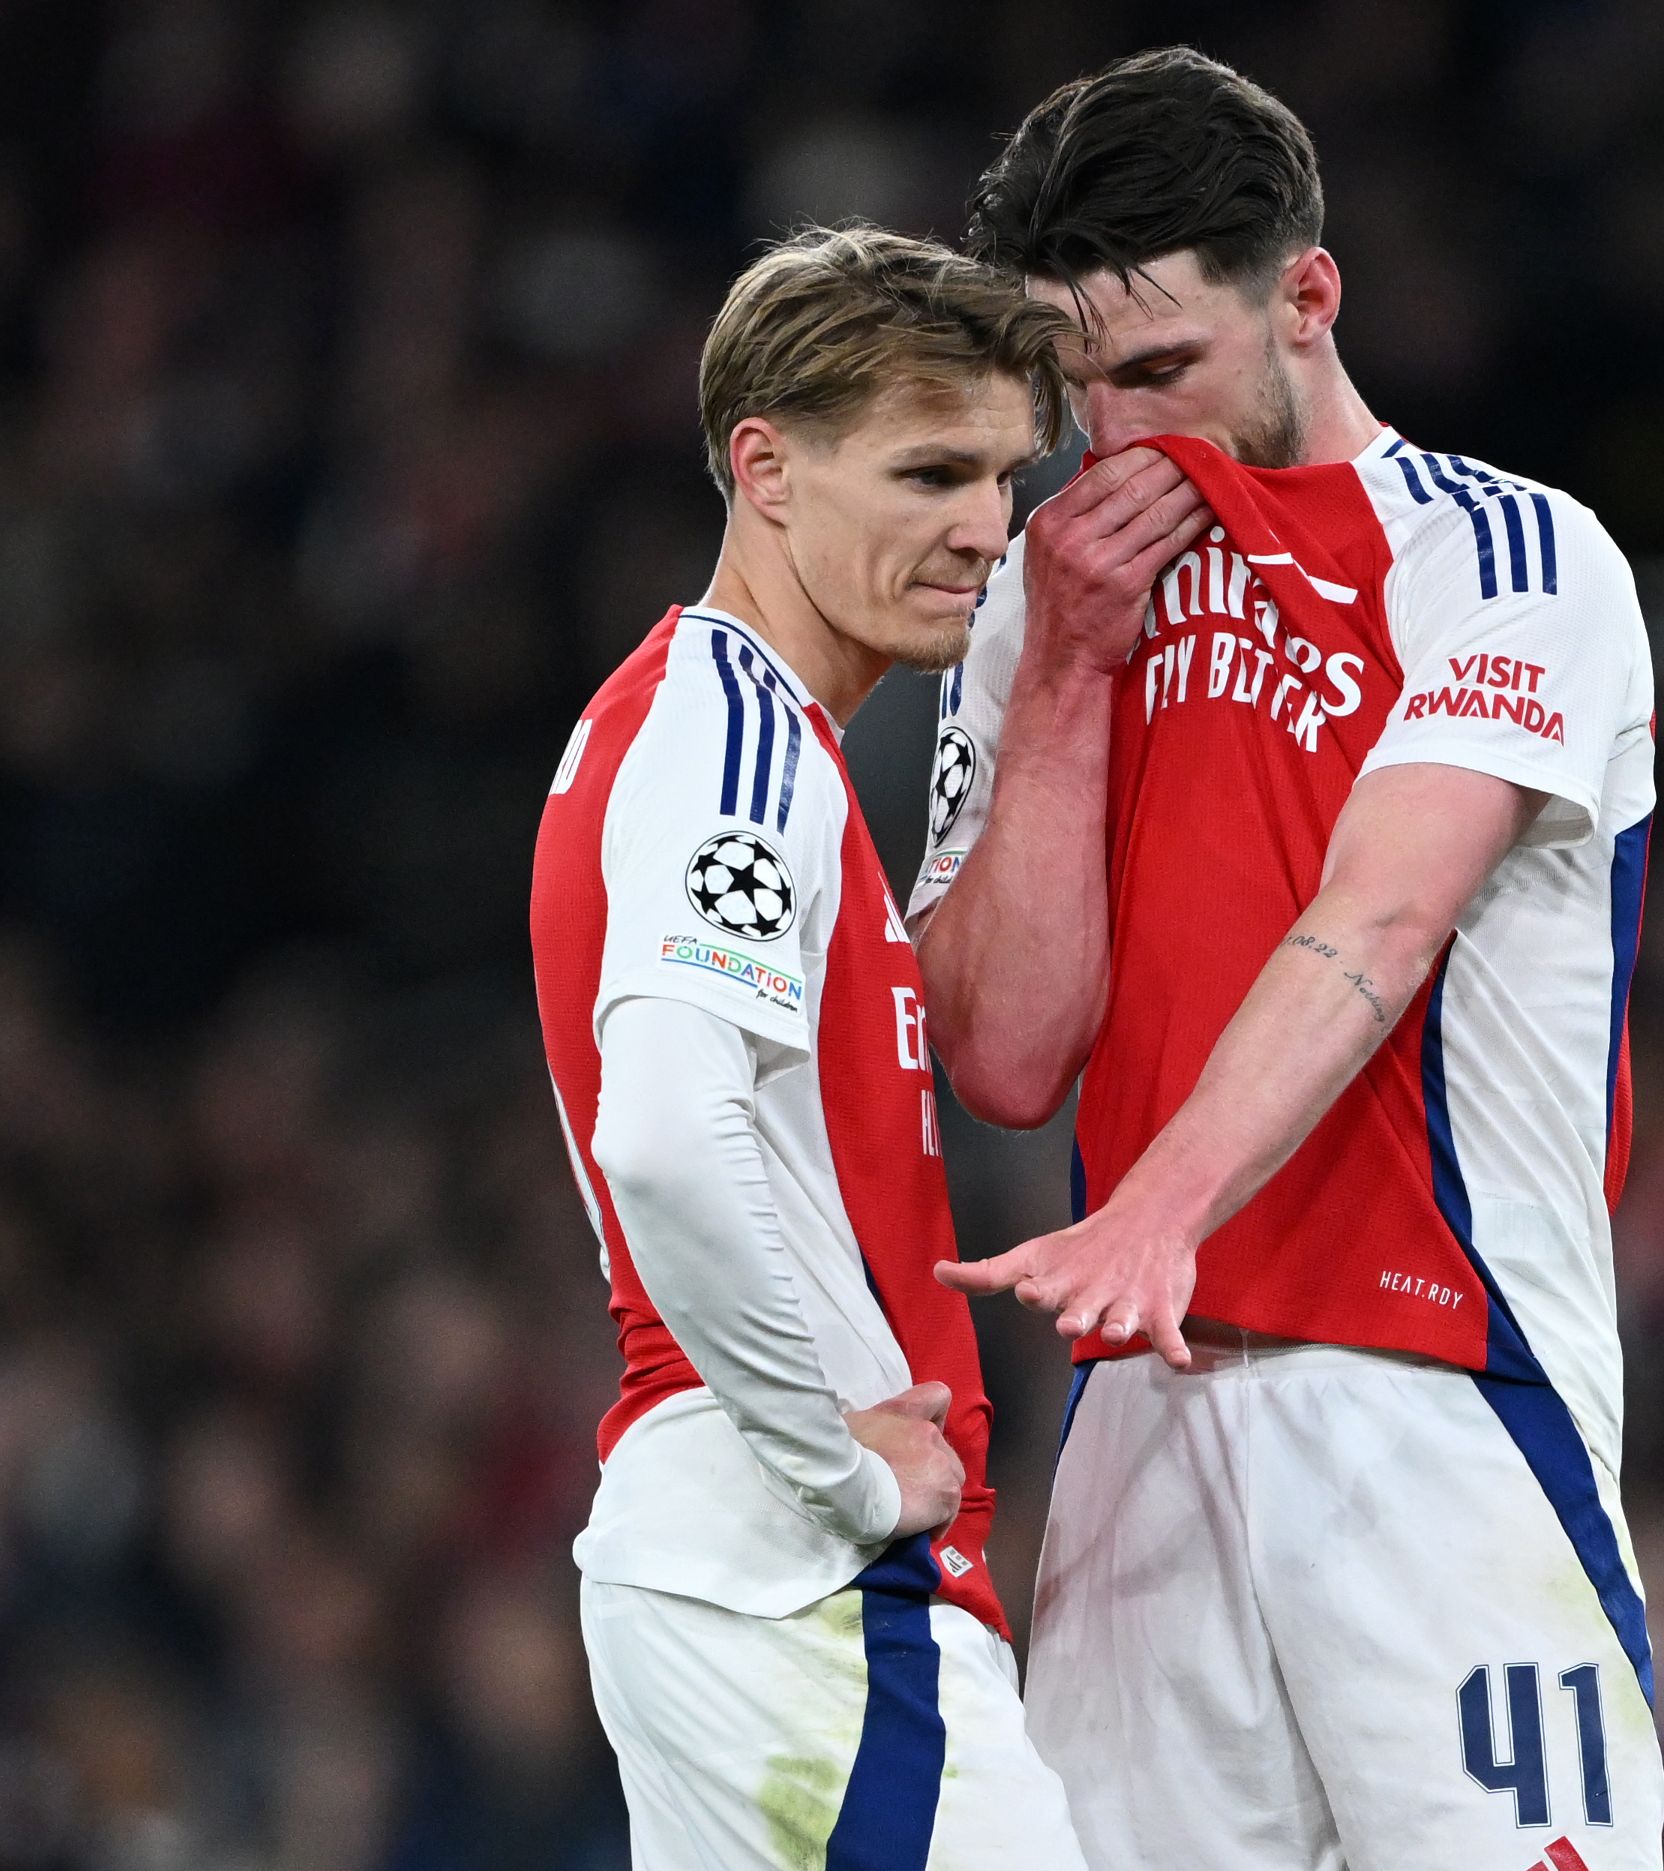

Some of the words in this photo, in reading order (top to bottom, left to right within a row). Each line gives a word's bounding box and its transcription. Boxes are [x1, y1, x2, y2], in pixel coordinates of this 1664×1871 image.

[1447, 653, 1546, 693] VISIT
[1403, 686, 1564, 748] RWANDA
[663, 934, 698, 945] UEFA
[661, 943, 802, 1001] FOUNDATION
[1379, 1270, 1464, 1310] HEAT.RDY
[1456, 1662, 1614, 1829] 41
